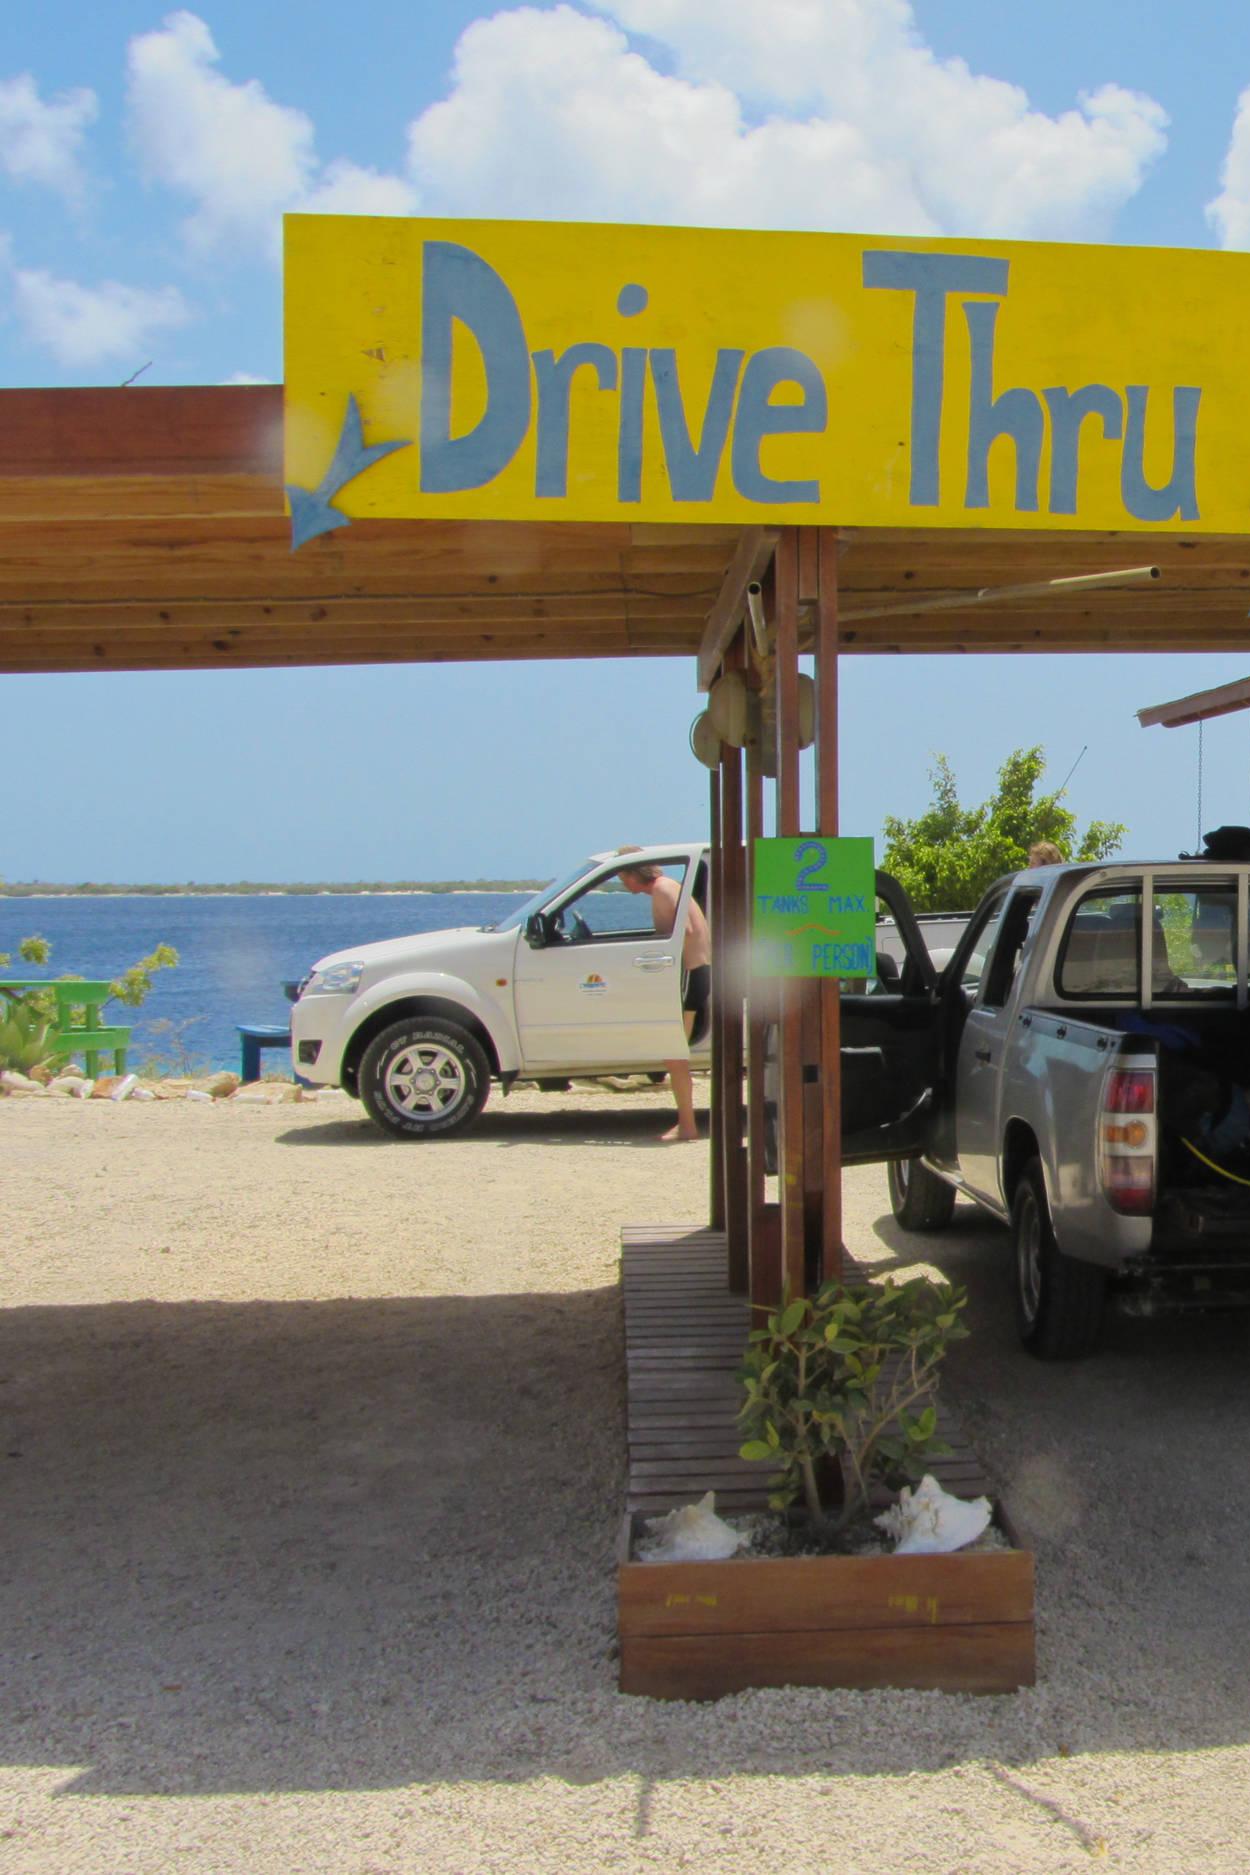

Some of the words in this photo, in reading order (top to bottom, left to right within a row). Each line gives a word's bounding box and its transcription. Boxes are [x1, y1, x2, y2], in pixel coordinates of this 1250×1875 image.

[420, 240, 828, 505] Drive
[861, 249, 1202, 522] Thru
[794, 841, 830, 892] 2
[757, 895, 809, 914] TANKS
